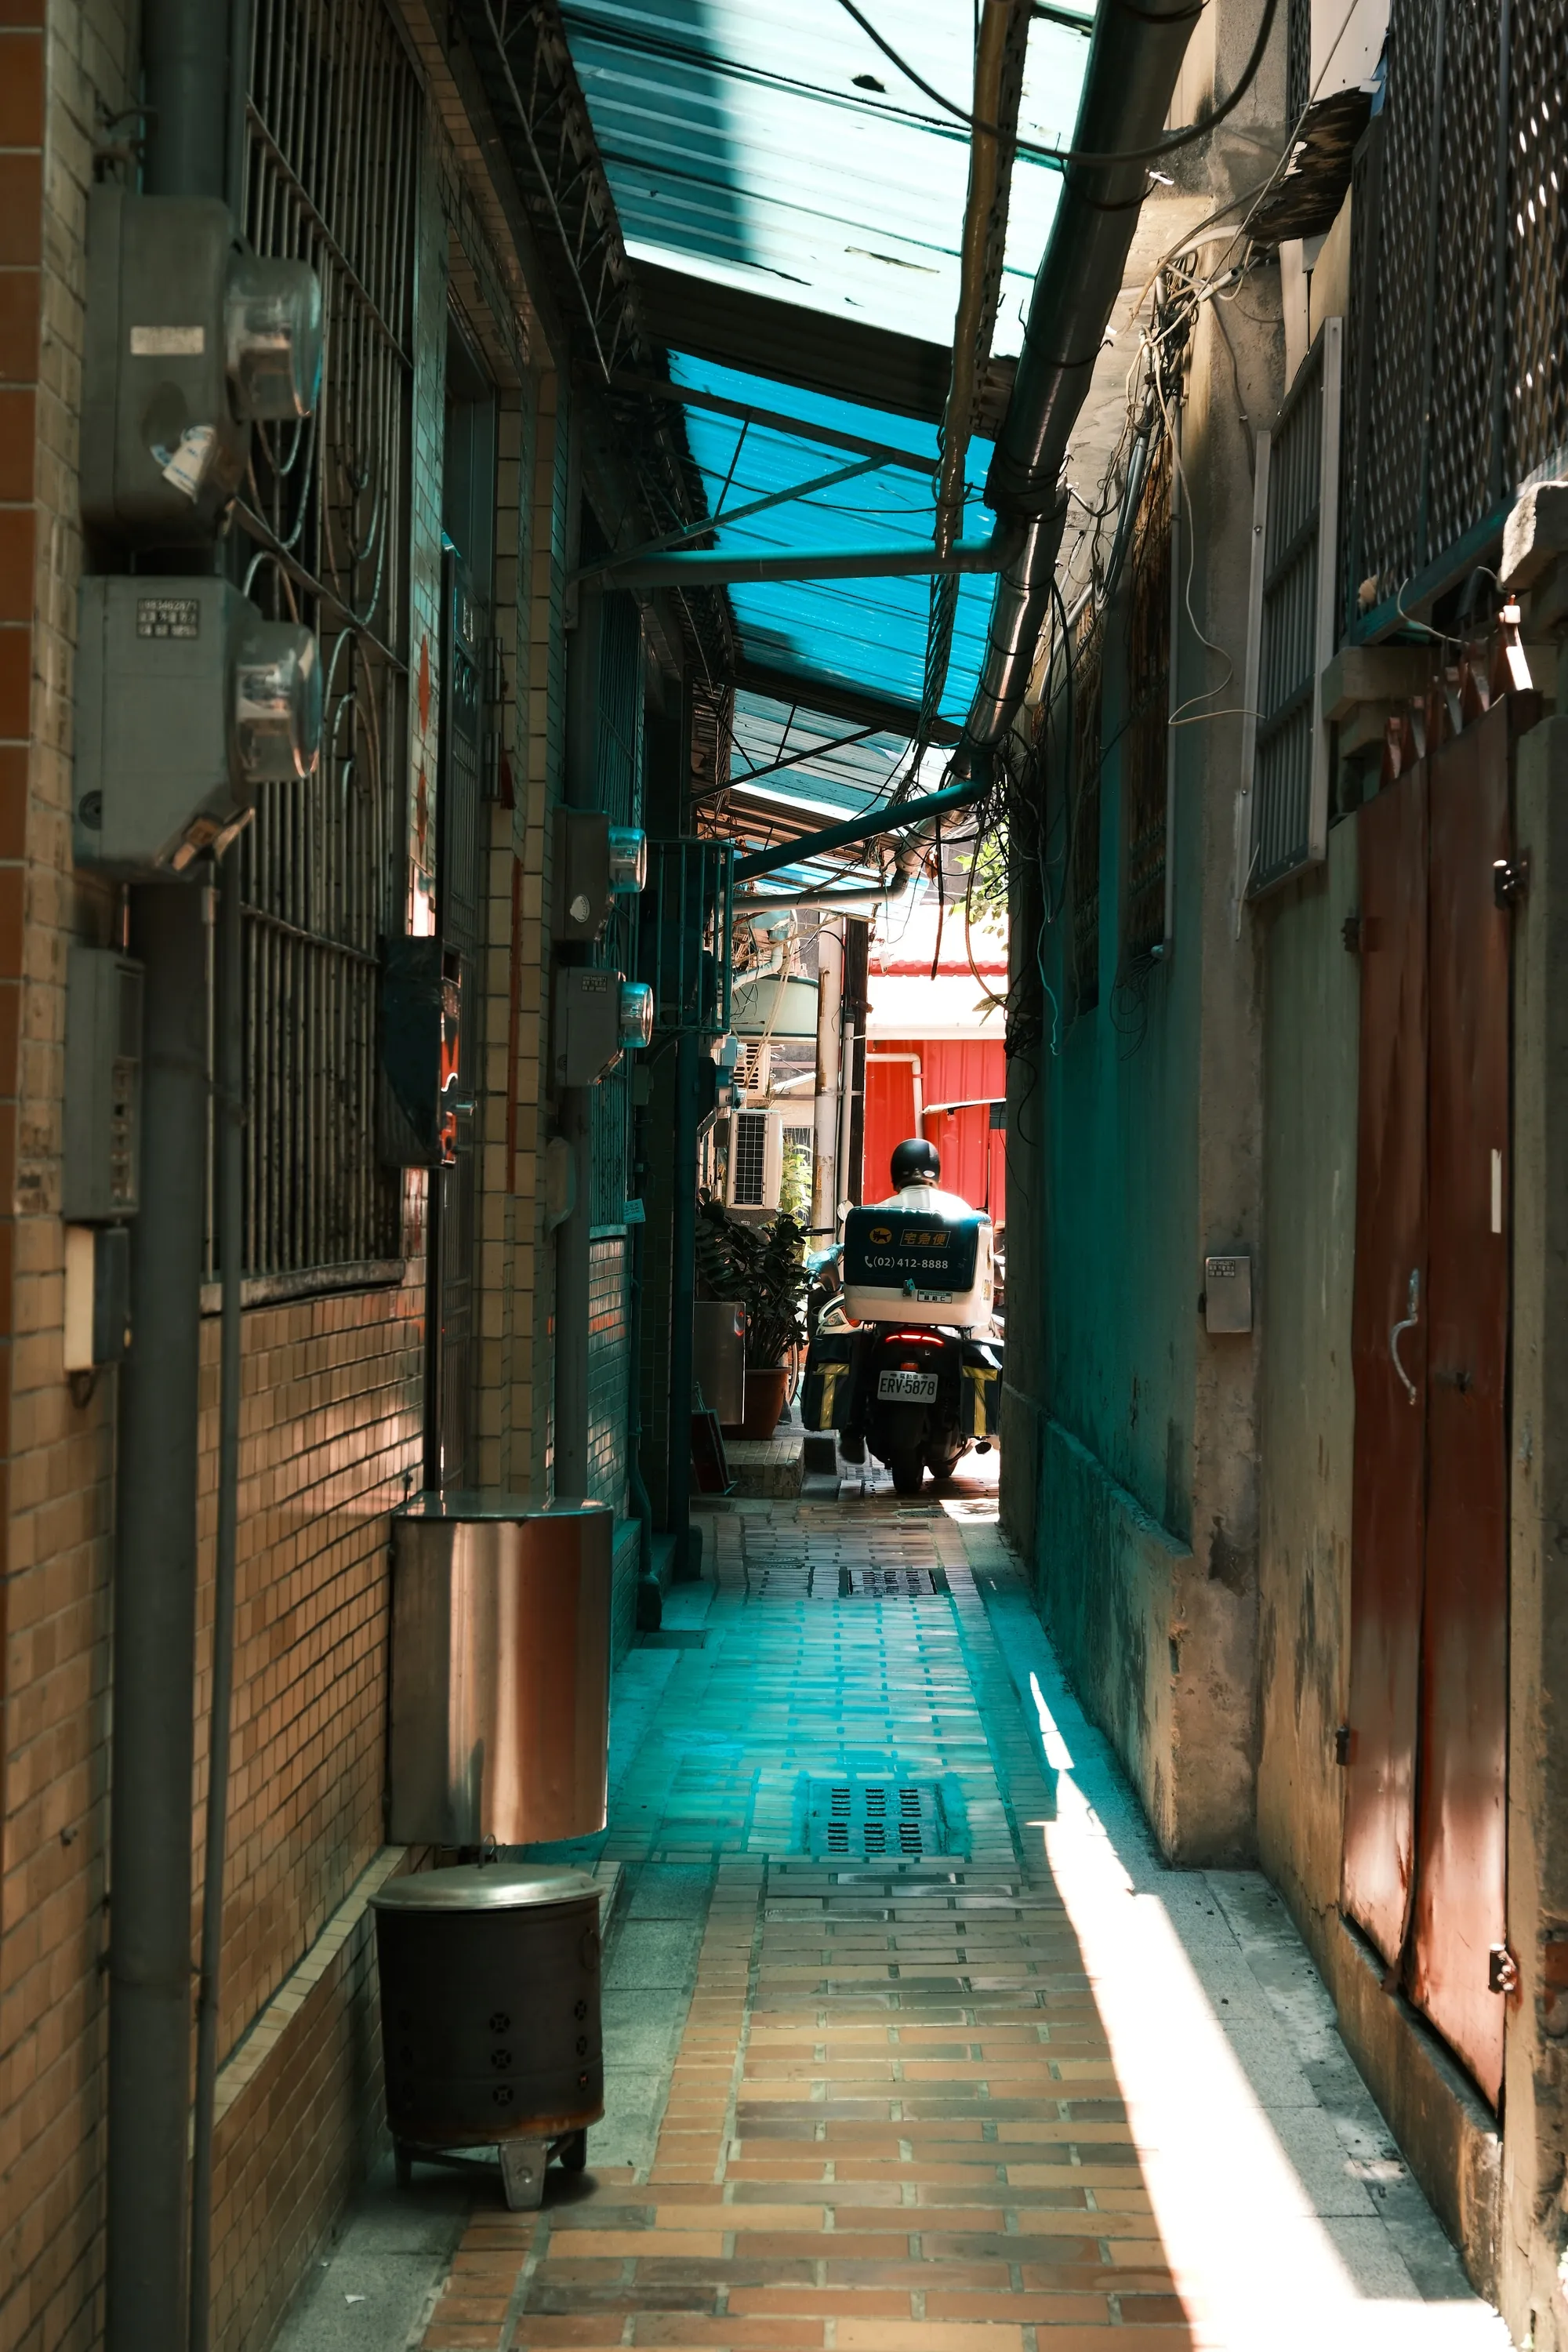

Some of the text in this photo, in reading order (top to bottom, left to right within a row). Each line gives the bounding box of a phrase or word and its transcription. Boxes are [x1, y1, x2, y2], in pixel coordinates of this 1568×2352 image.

[903, 1232, 947, 1246] 宅急便
[873, 1255, 949, 1269] (02) 412-8888
